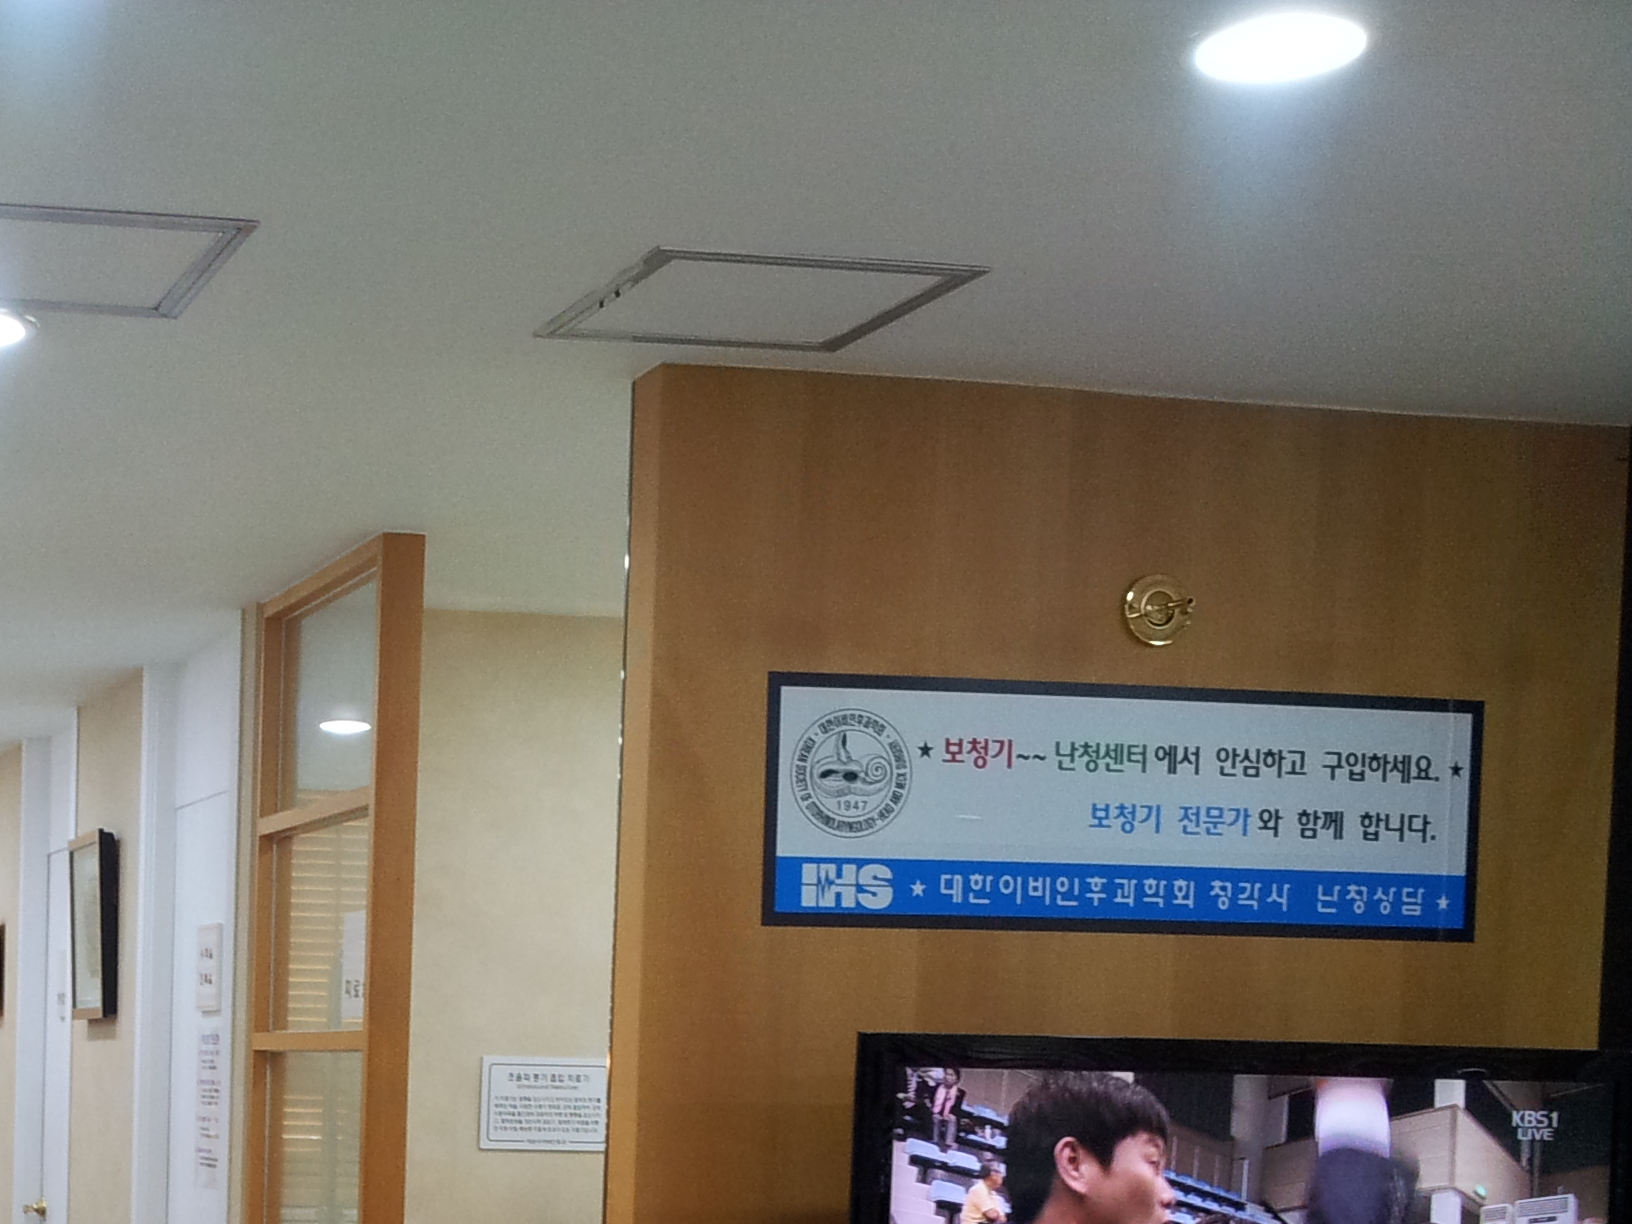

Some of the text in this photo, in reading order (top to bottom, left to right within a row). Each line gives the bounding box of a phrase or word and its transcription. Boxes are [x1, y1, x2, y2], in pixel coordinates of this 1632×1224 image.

[1216, 747, 1308, 778] 안심하고
[1322, 751, 1440, 784] 구입하세요.
[836, 800, 869, 812] 1947
[1088, 803, 1162, 834] 보청기
[1297, 809, 1345, 840] 함께
[1360, 811, 1436, 843] 합니다.
[939, 873, 1426, 916] 대한이비인후과학회 청각사 난청상담
[1517, 1128, 1555, 1141] LIVE
